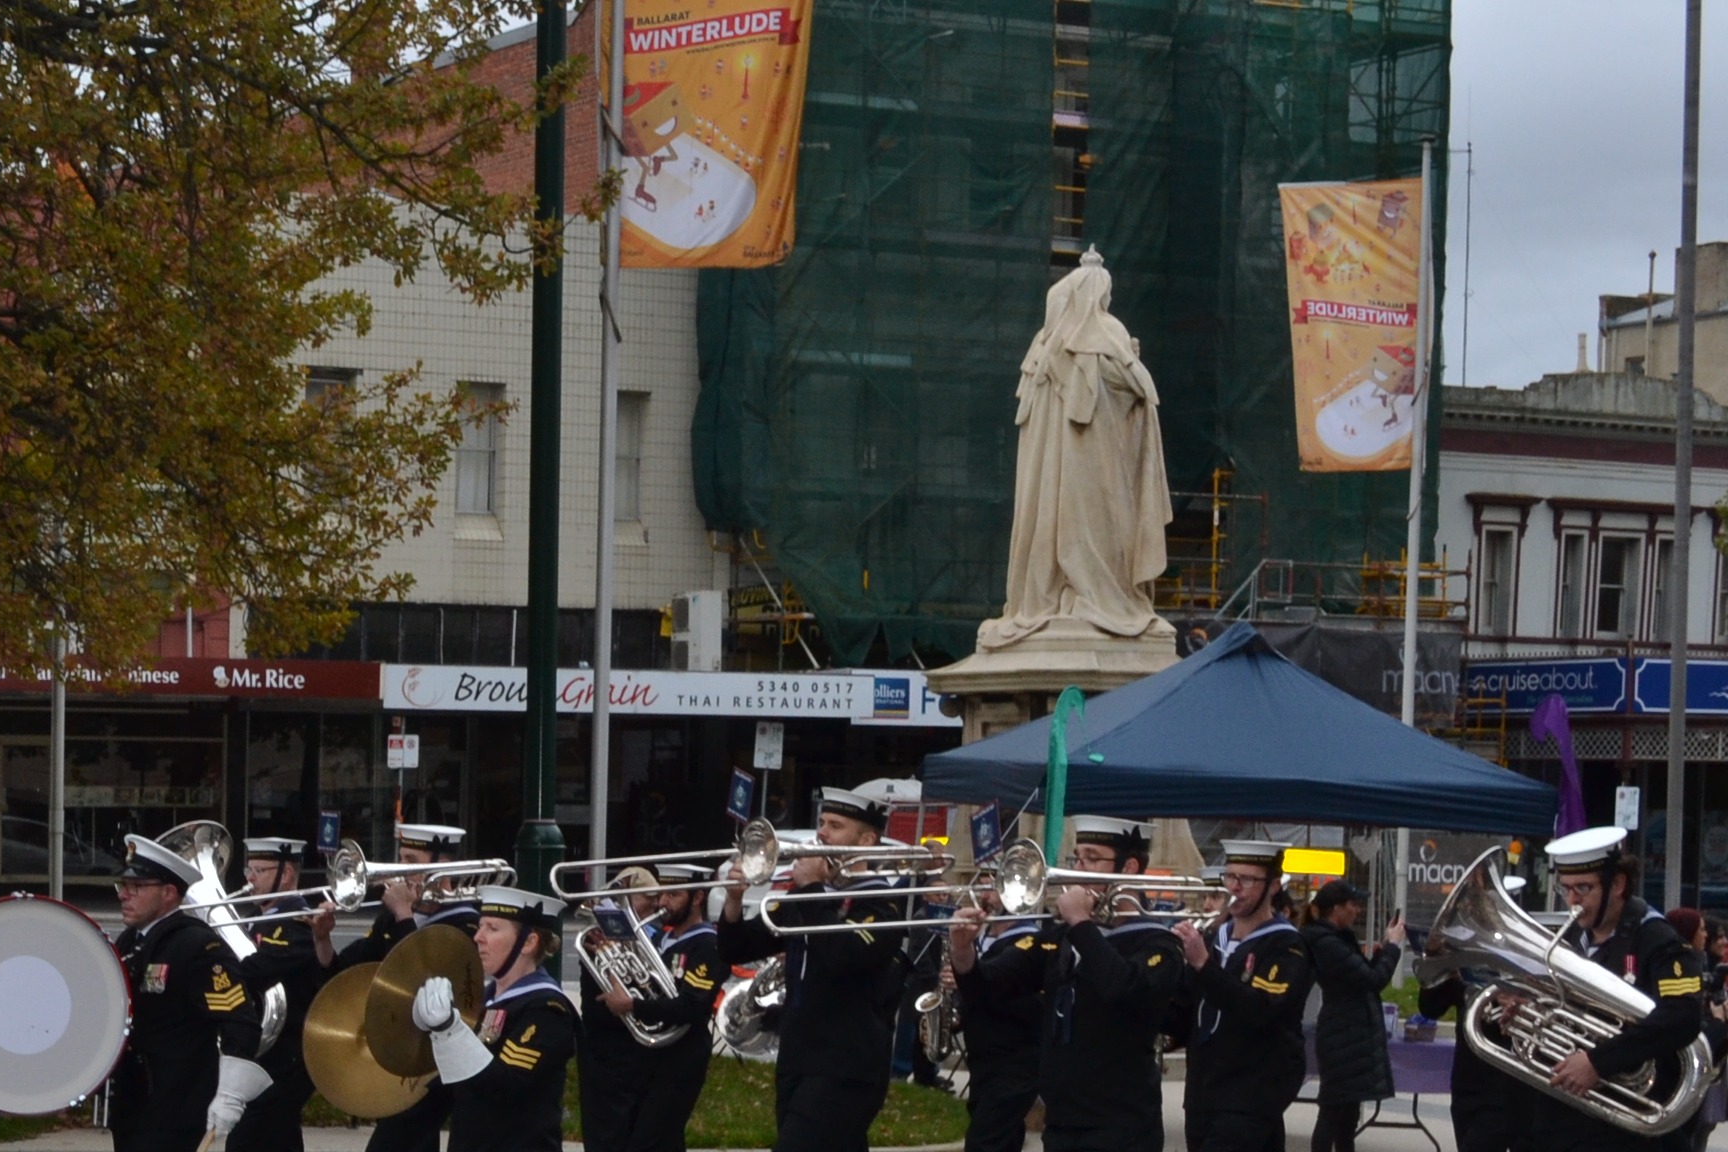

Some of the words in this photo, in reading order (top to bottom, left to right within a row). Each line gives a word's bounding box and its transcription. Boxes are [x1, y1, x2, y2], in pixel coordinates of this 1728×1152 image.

[637, 10, 691, 26] BALLARAT
[629, 10, 783, 53] WINTERLUDE
[118, 664, 179, 684] hinese
[231, 667, 262, 688] Mr.
[265, 667, 306, 689] Rice
[1487, 665, 1594, 692] cruiseabout
[557, 675, 659, 709] Grin
[757, 680, 799, 693] 5340
[811, 682, 853, 694] 0517
[874, 684, 906, 699] olliers
[677, 695, 720, 707] THAI
[733, 696, 853, 710] RESTAURANT
[1408, 863, 1466, 884] macn
